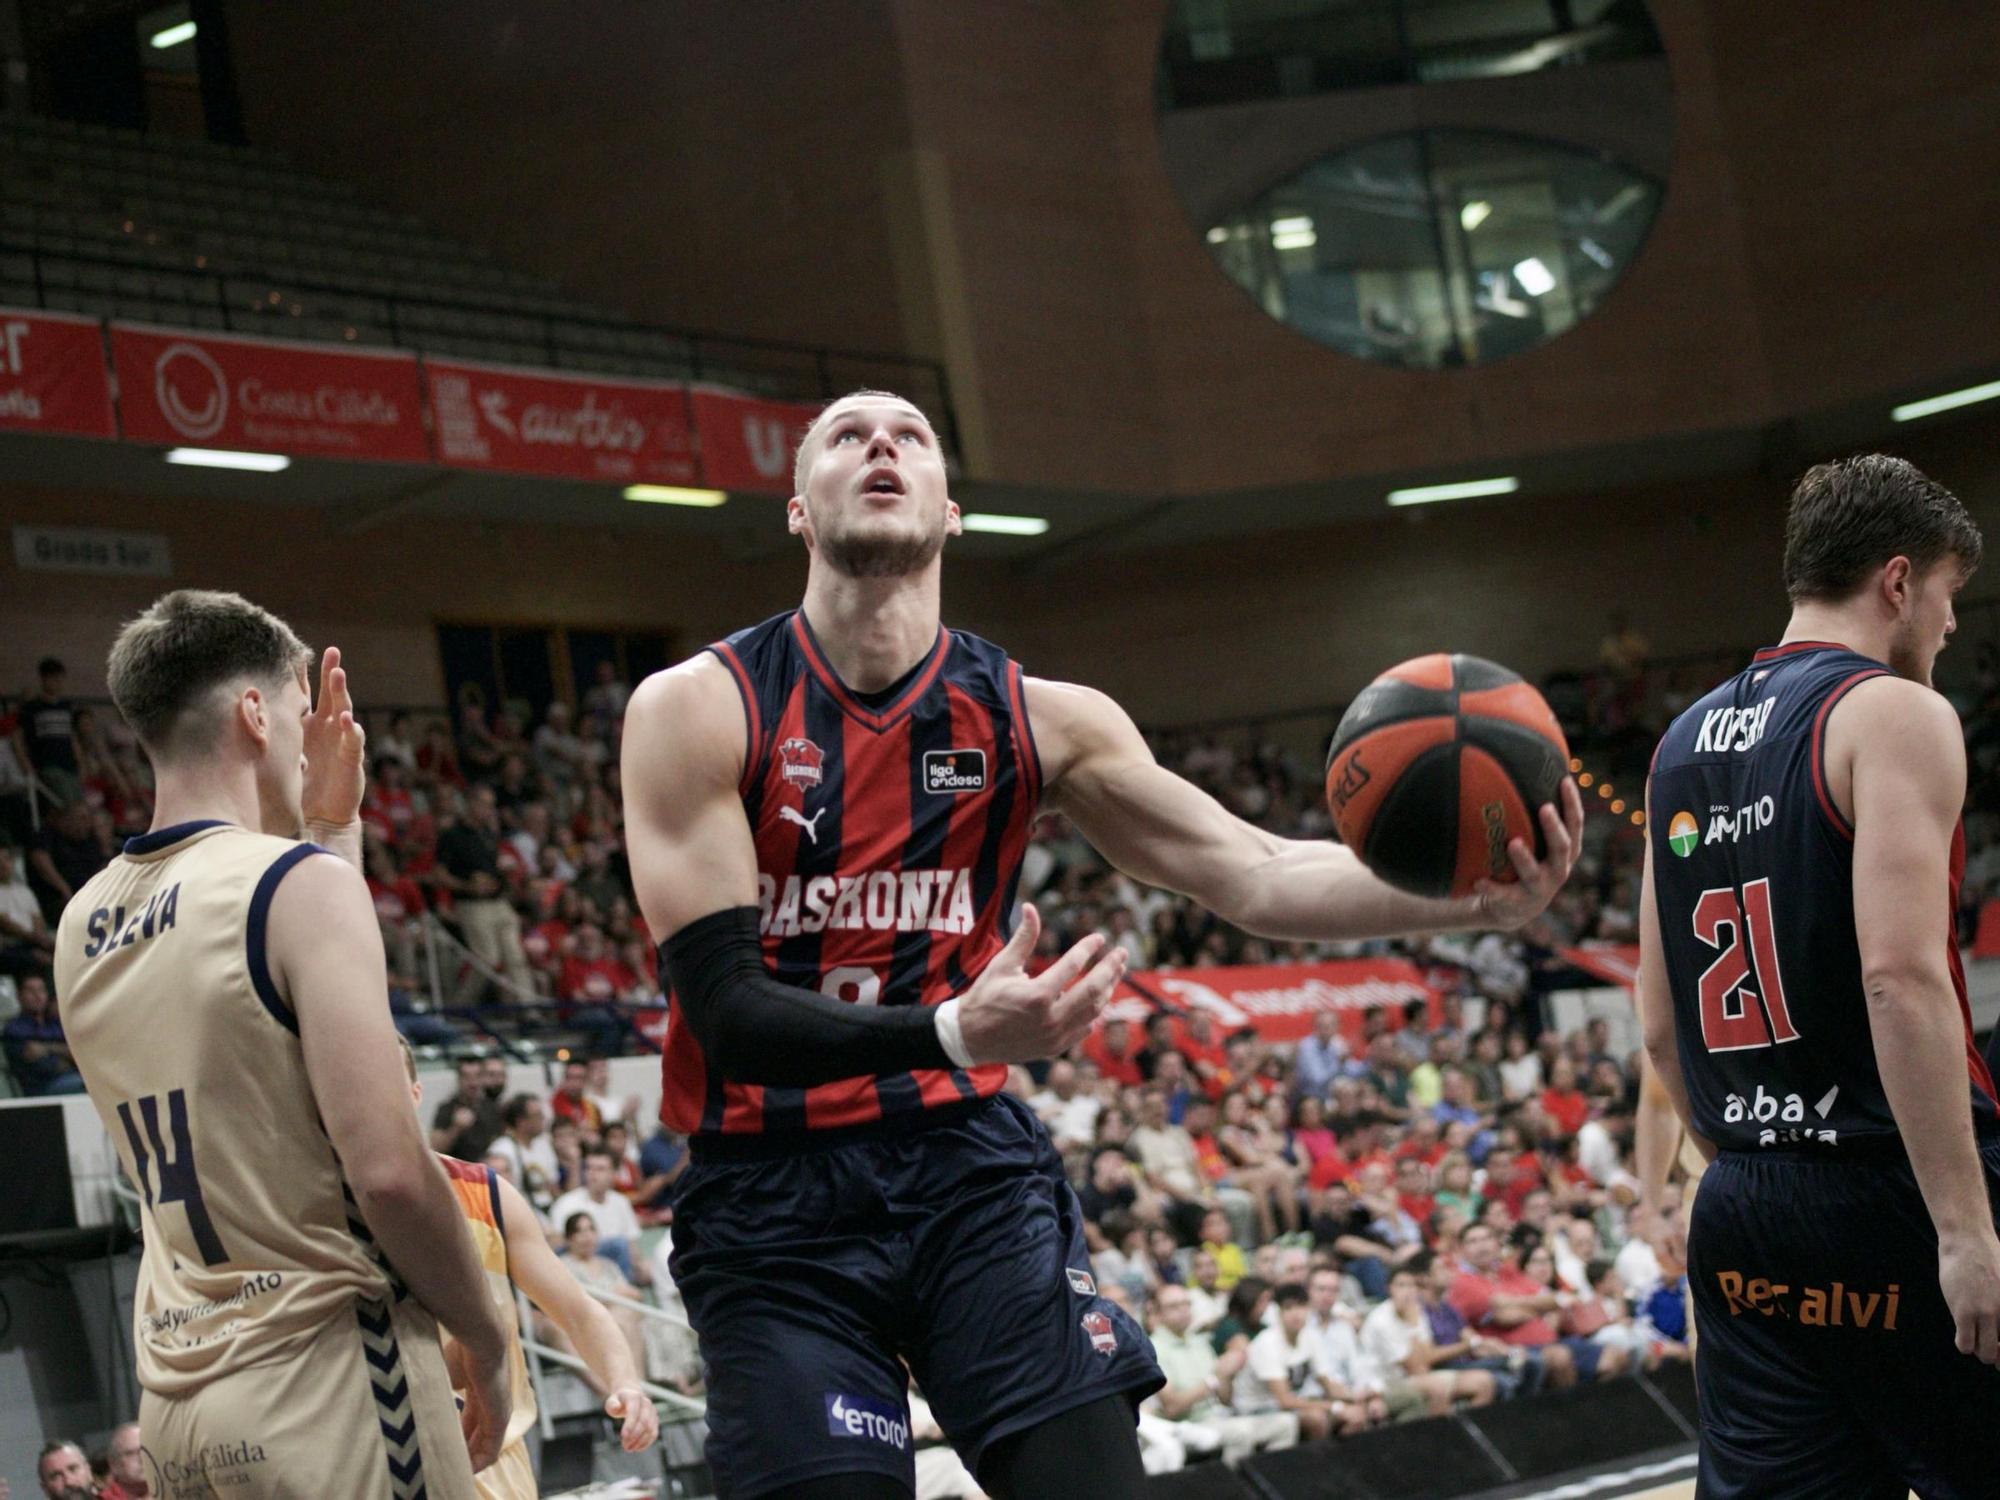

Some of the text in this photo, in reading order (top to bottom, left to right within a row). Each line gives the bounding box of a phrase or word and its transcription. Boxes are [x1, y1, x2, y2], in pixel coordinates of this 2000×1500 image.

[930, 763, 954, 777] liga
[930, 774, 982, 788] endesa
[1692, 877, 1801, 1052] 21
[116, 1088, 231, 1271] 14
